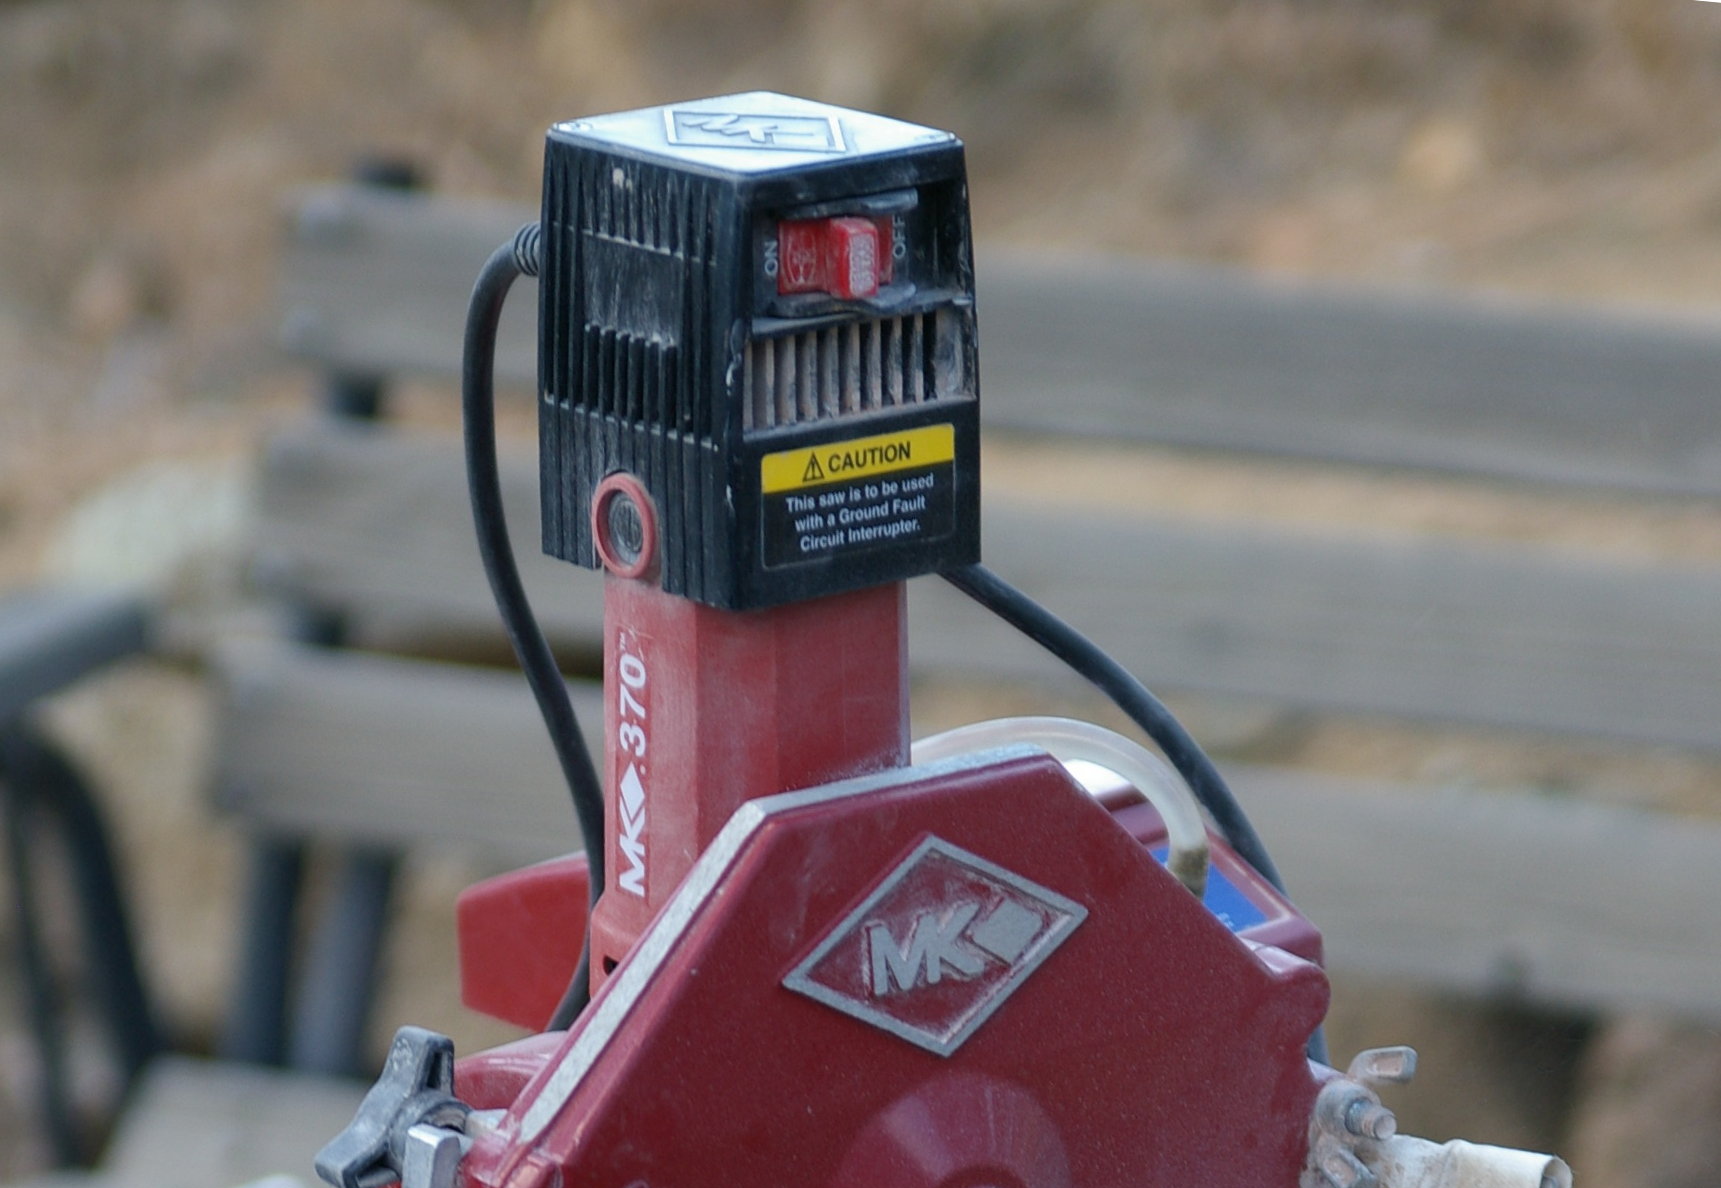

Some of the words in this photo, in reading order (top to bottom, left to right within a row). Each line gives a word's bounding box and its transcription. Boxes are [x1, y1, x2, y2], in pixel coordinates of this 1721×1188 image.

[764, 240, 778, 276] ON
[892, 214, 906, 260] OFF
[828, 441, 911, 474] CAUTION
[785, 494, 816, 514] This
[819, 492, 846, 508] saw
[849, 485, 861, 502] is
[864, 483, 879, 499] to
[881, 479, 898, 495] be
[902, 472, 934, 493] used
[795, 513, 824, 532] with
[827, 514, 836, 527] a
[839, 503, 889, 525] Ground
[893, 495, 926, 515] Fault
[800, 529, 845, 552] Circuit
[849, 517, 921, 542] Interrupter.
[619, 652, 646, 758] 370
[619, 796, 646, 897] MK
[869, 902, 985, 997] MK
